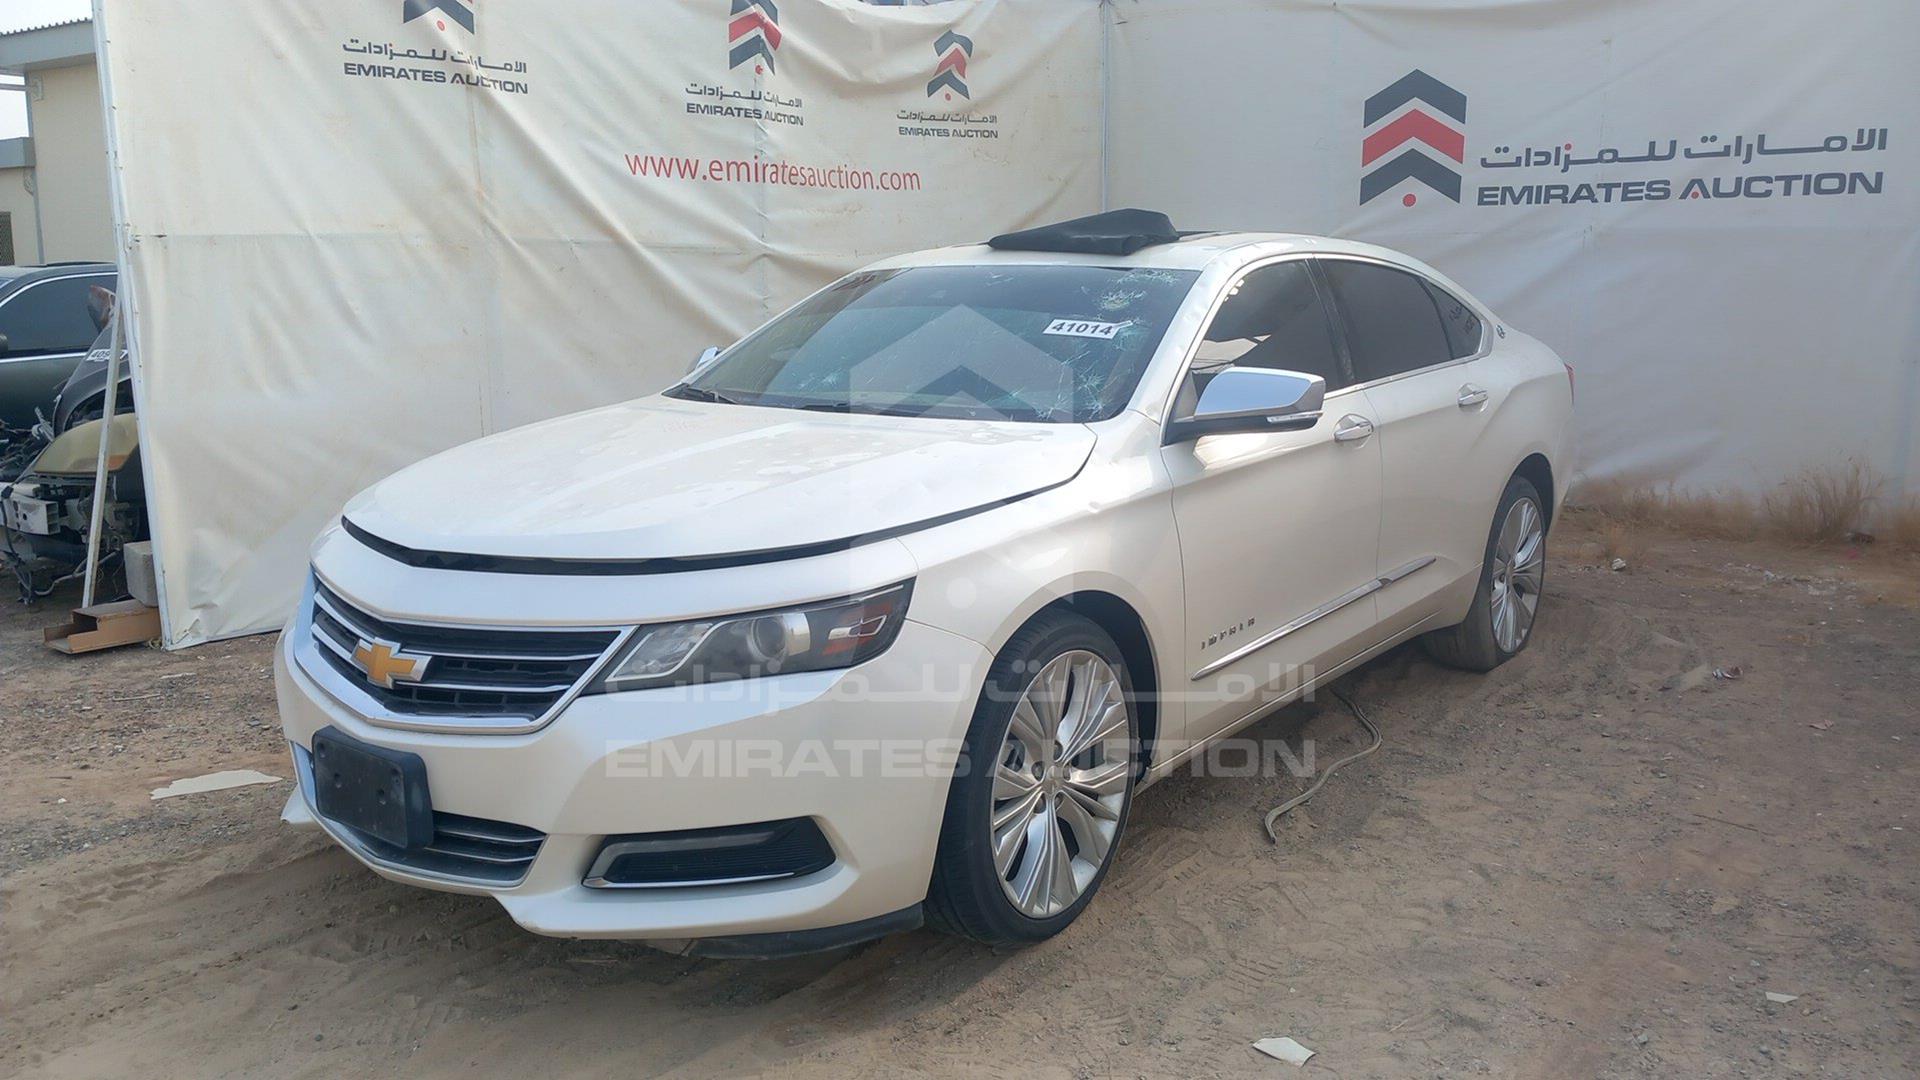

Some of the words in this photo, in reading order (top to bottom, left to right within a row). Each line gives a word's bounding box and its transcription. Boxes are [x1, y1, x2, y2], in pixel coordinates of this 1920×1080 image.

[342, 38, 446, 60] للمزادات
[451, 50, 527, 74] الامارات
[344, 62, 446, 83] EMIRATES
[450, 72, 528, 95] AUCTION
[686, 102, 763, 119] EMIRATES
[763, 110, 804, 126] AUCTION
[898, 126, 950, 138] EMIRATES
[952, 128, 999, 139] AUCTION
[1683, 127, 1889, 165] الامارات
[1479, 139, 1678, 173] للمزادات
[623, 153, 922, 192] www.emiratesauction.com
[1476, 178, 1673, 207] EMIRATES
[1677, 170, 1885, 201] AUCTION
[1051, 321, 1114, 336] 41014
